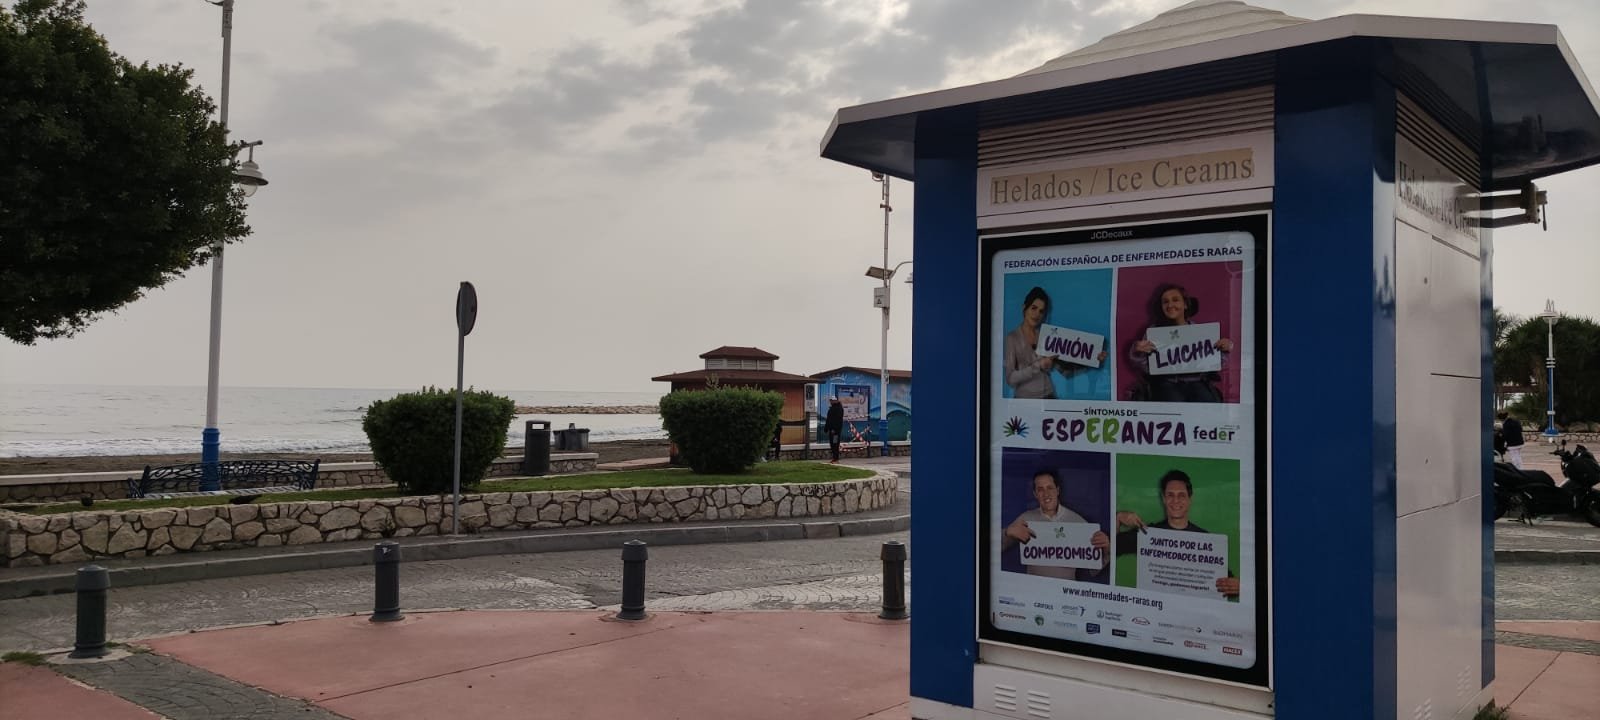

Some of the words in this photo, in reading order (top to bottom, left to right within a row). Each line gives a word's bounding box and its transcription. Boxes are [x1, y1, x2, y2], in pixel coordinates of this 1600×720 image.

[992, 173, 1082, 204] Helados
[1089, 168, 1099, 195] /
[1107, 167, 1143, 193] Ice
[1151, 157, 1253, 188] Creams
[1090, 229, 1133, 240] JCDecaux
[1004, 256, 1059, 269] FEDERACIÓN
[1061, 254, 1110, 265] ESPAÑOLA
[1111, 254, 1124, 263] DE
[1125, 248, 1205, 262] ENFERMEDADES
[1207, 246, 1242, 256] RARAS
[1044, 336, 1094, 360] UNIÓN
[1155, 339, 1215, 368] LUCHA
[1083, 406, 1125, 417] SÍNTOMAS
[1126, 409, 1138, 417] DE
[1042, 417, 1187, 446] ESPERANZA
[1193, 425, 1235, 441] feder
[1023, 546, 1101, 561] COMPROMISO
[1150, 537, 1178, 549] JUNTOS
[1180, 541, 1196, 551] POR
[1197, 542, 1213, 552] LAS
[1140, 547, 1197, 563] ENFERMEDADES
[1198, 554, 1225, 566] RARAS
[1062, 586, 1163, 611] www.enfermedades-raras.org
